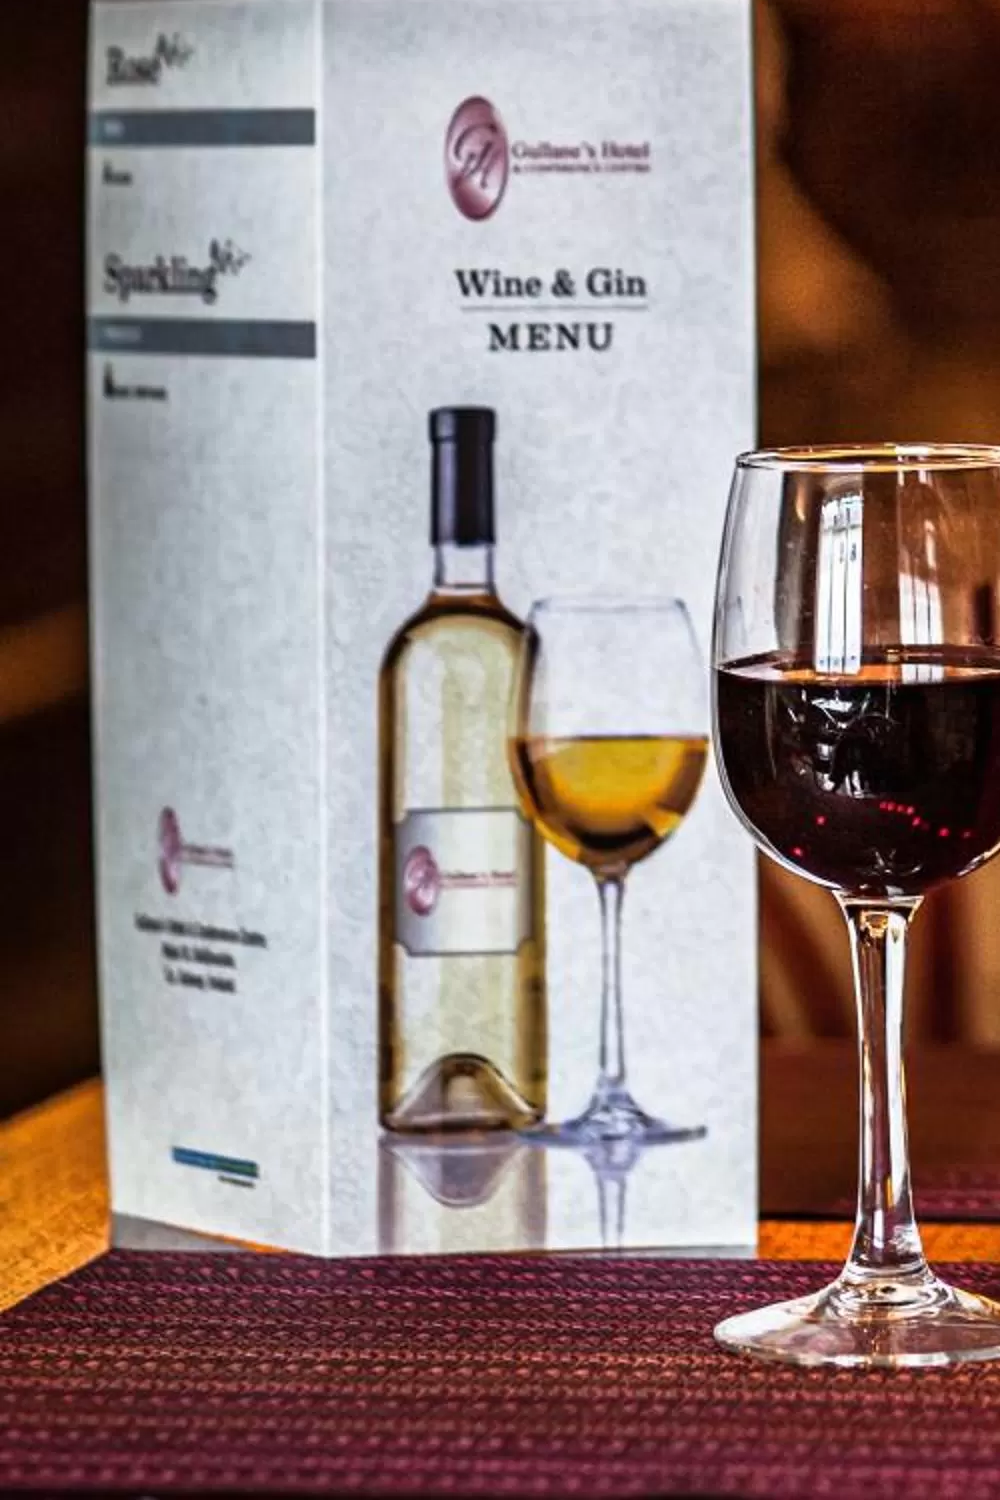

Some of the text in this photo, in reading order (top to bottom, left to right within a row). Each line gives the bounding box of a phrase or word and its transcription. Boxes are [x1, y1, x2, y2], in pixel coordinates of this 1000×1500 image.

[601, 139, 650, 159] Hotel
[104, 252, 218, 306] Sparkling
[454, 267, 648, 298] Wine & Gin
[488, 322, 614, 353] MENU
